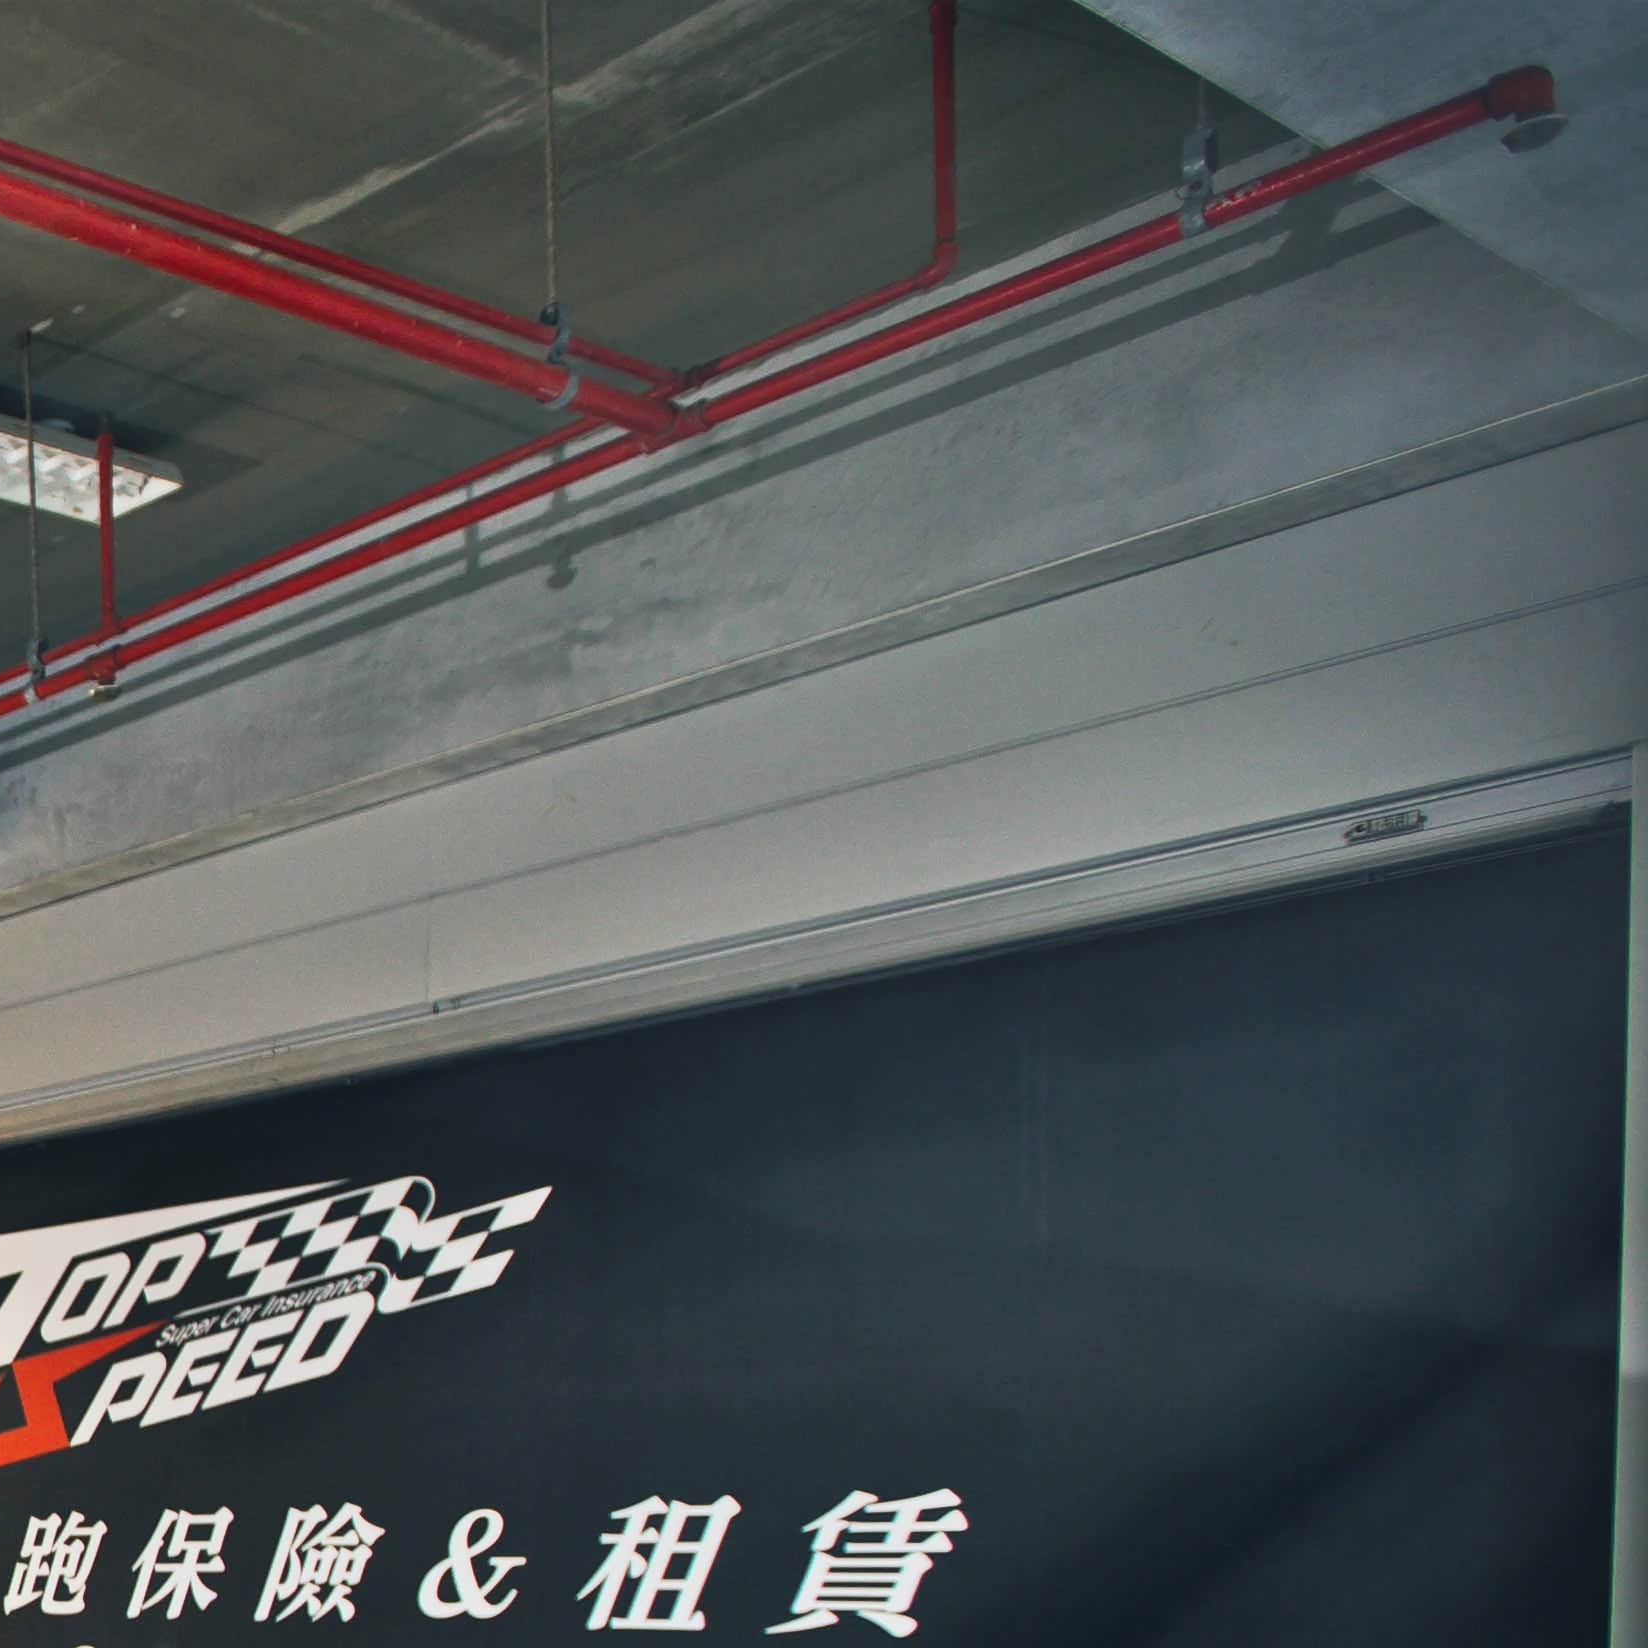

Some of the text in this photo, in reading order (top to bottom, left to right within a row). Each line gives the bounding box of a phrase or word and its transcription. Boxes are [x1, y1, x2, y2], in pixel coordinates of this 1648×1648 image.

[156, 1270, 378, 1347] Super Car Insurance
[418, 1509, 527, 1619] &
[576, 1488, 969, 1638] 租賃
